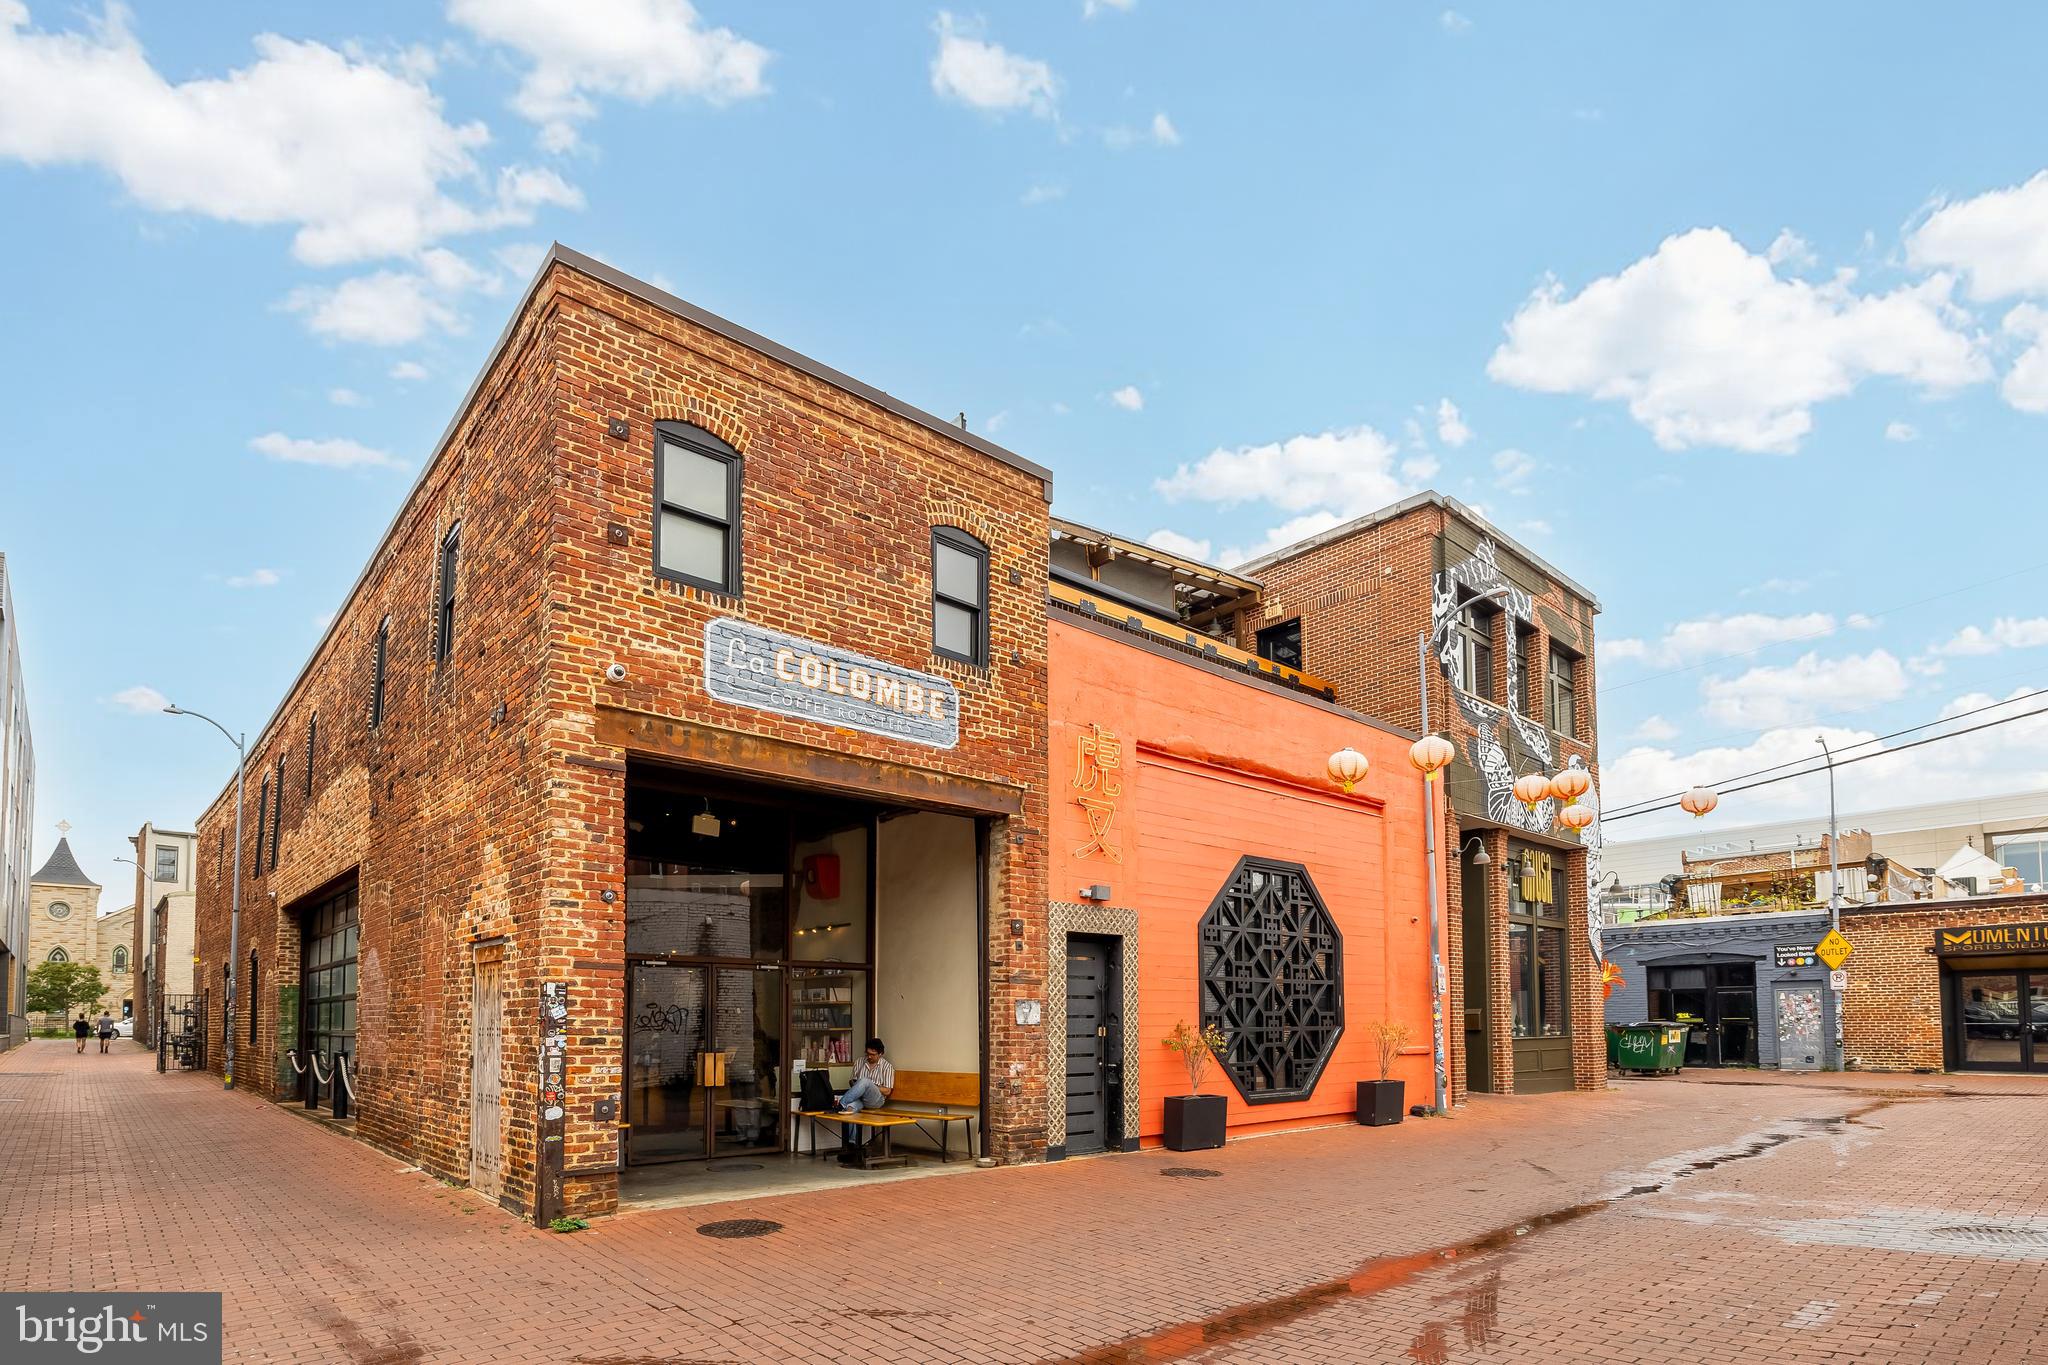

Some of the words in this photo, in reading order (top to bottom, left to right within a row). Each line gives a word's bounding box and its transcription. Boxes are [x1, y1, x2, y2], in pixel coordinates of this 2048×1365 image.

[724, 637, 767, 675] La
[774, 648, 946, 721] COLOMBE
[770, 690, 829, 715] COFFEE
[838, 707, 912, 734] ROASTERS
[1821, 948, 1848, 956] OUTLET
[1944, 944, 2002, 952] SPORTS
